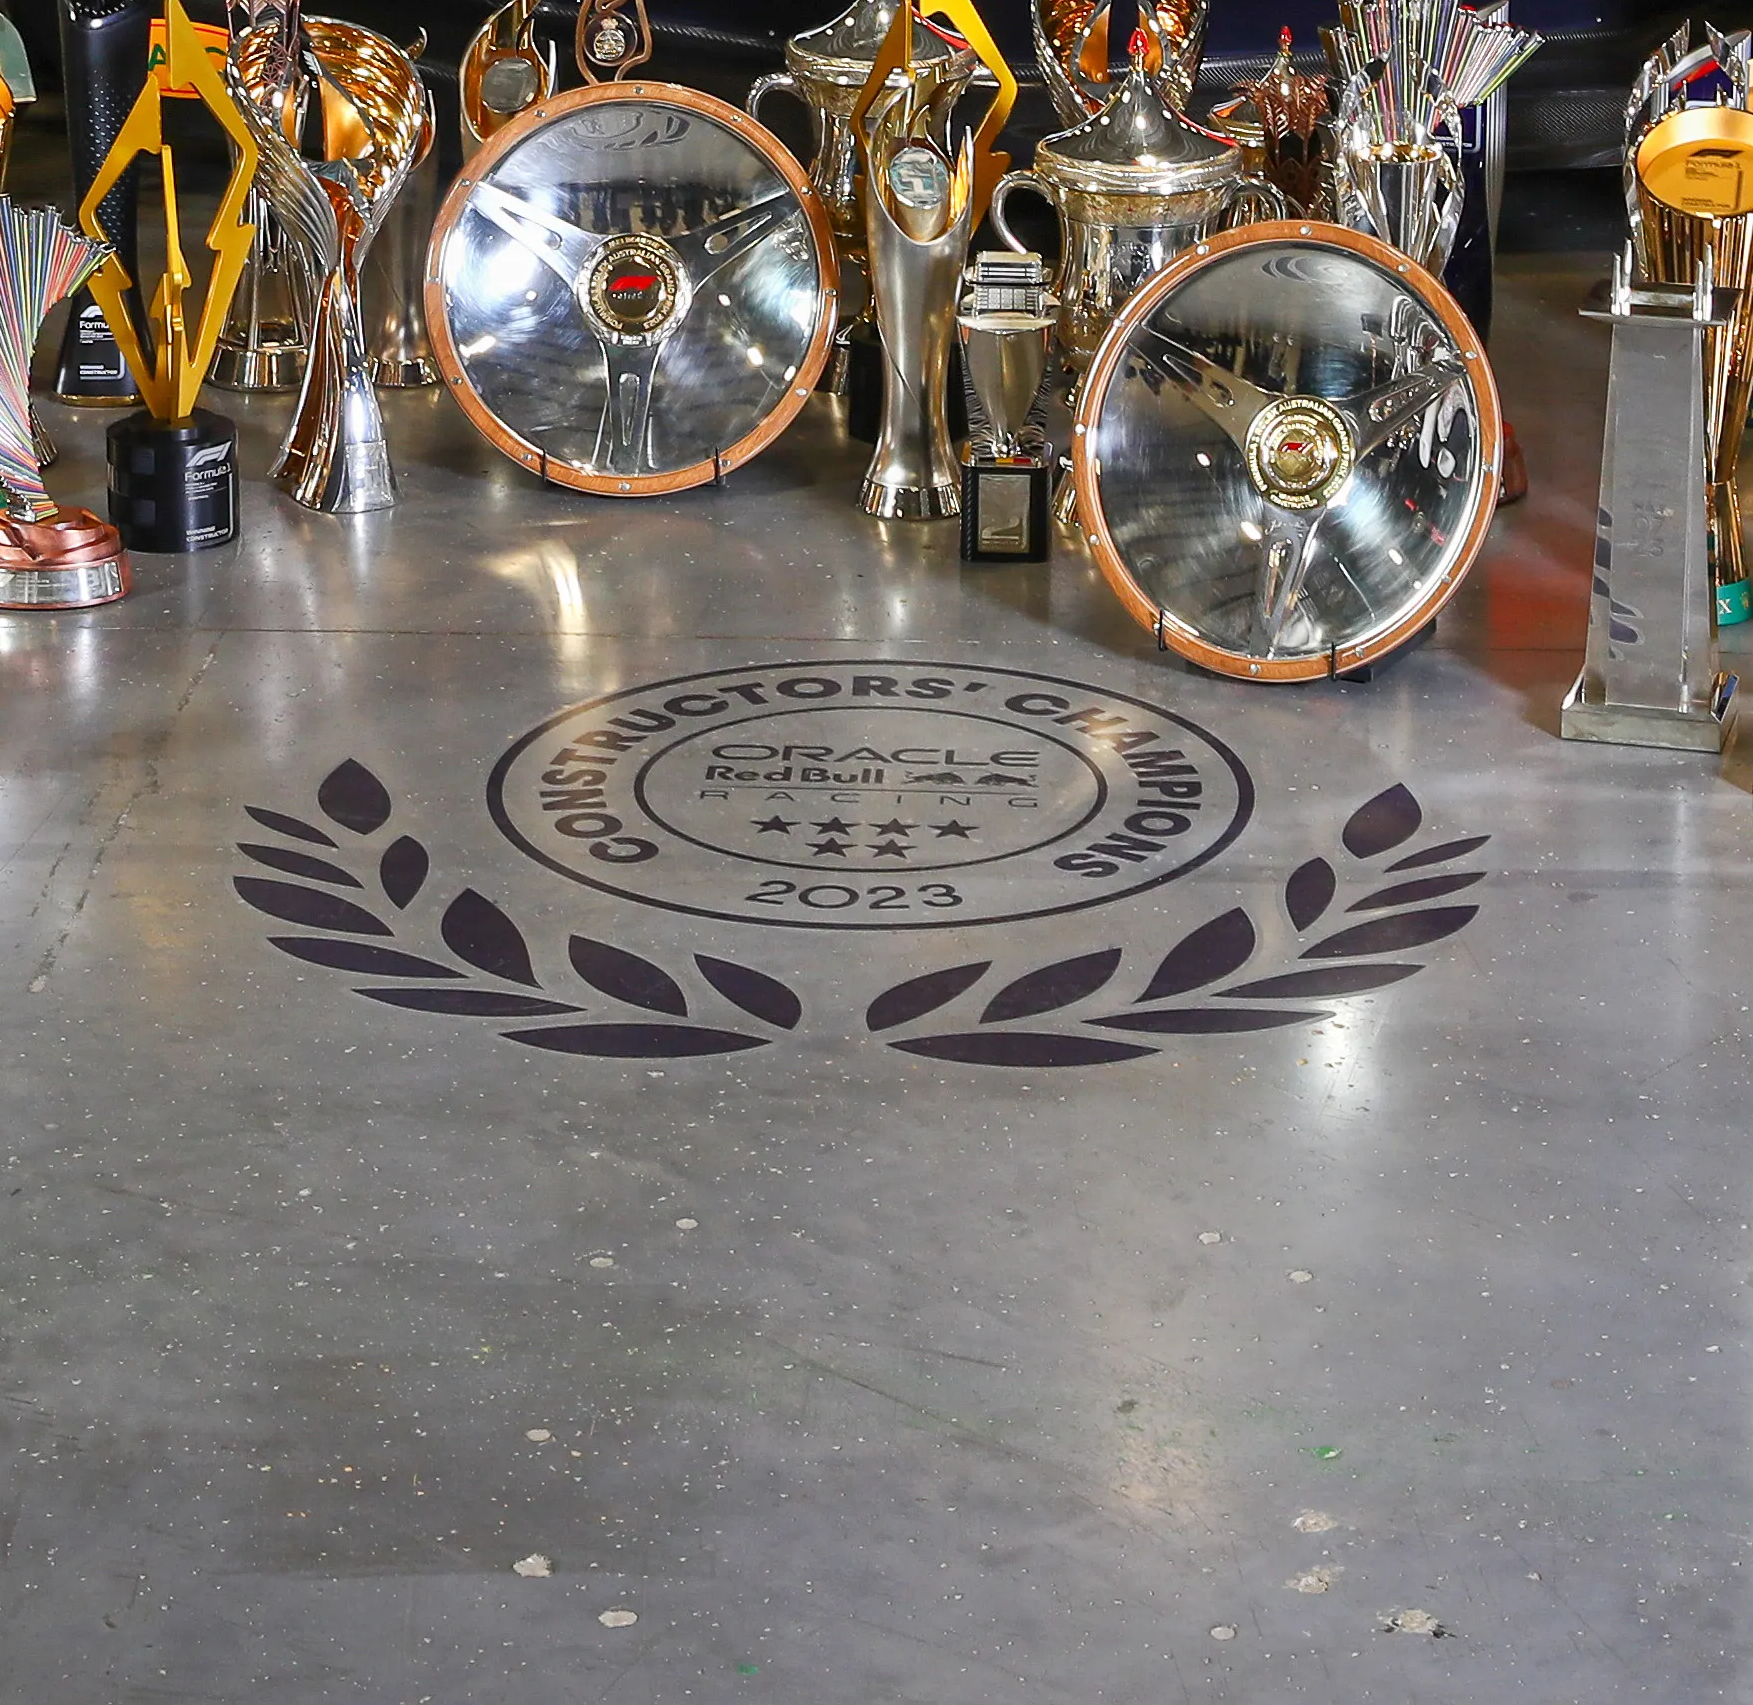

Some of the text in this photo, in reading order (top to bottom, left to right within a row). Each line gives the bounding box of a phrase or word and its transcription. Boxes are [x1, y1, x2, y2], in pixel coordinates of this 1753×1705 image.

[607, 248, 663, 265] AUSTRALIAN
[79, 320, 110, 330] Formu
[1278, 399, 1337, 421] AUSTRALIAN
[184, 465, 227, 483] Formula
[709, 743, 1042, 768] ORACLE
[703, 763, 886, 786] Red Bull
[1003, 691, 1202, 879] CHAMPIONS
[698, 789, 1040, 809] RACING
[743, 879, 965, 911] 2023
